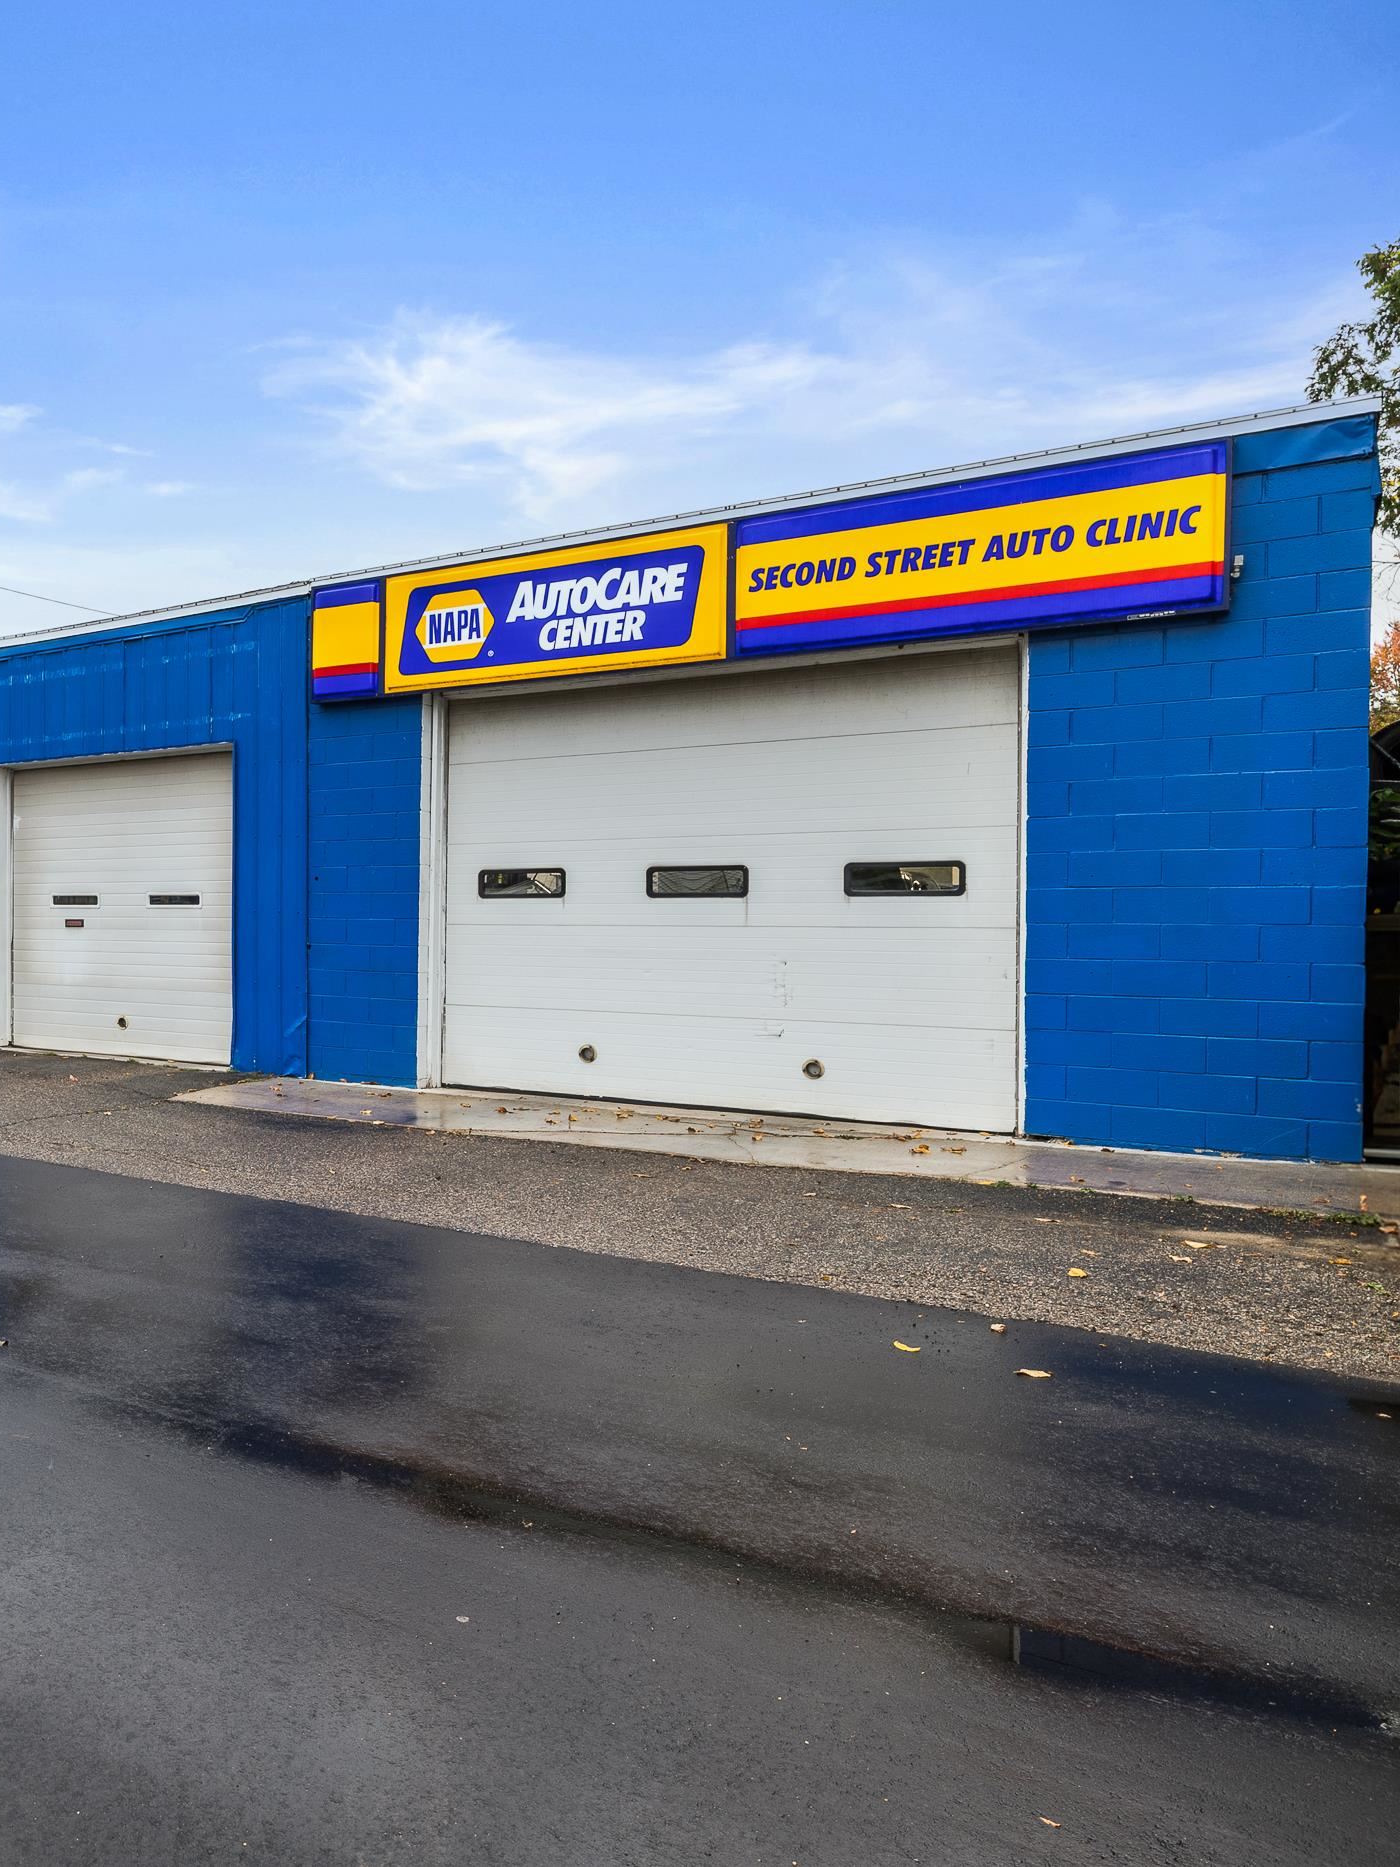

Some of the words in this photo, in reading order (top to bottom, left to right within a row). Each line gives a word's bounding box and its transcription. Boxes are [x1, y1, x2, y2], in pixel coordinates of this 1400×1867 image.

[748, 557, 856, 593] SECOND
[864, 539, 975, 578] STREET
[982, 524, 1075, 563] AUTO
[1086, 505, 1202, 547] CLINIC
[428, 608, 481, 645] NAPA
[538, 609, 646, 651] CENTER
